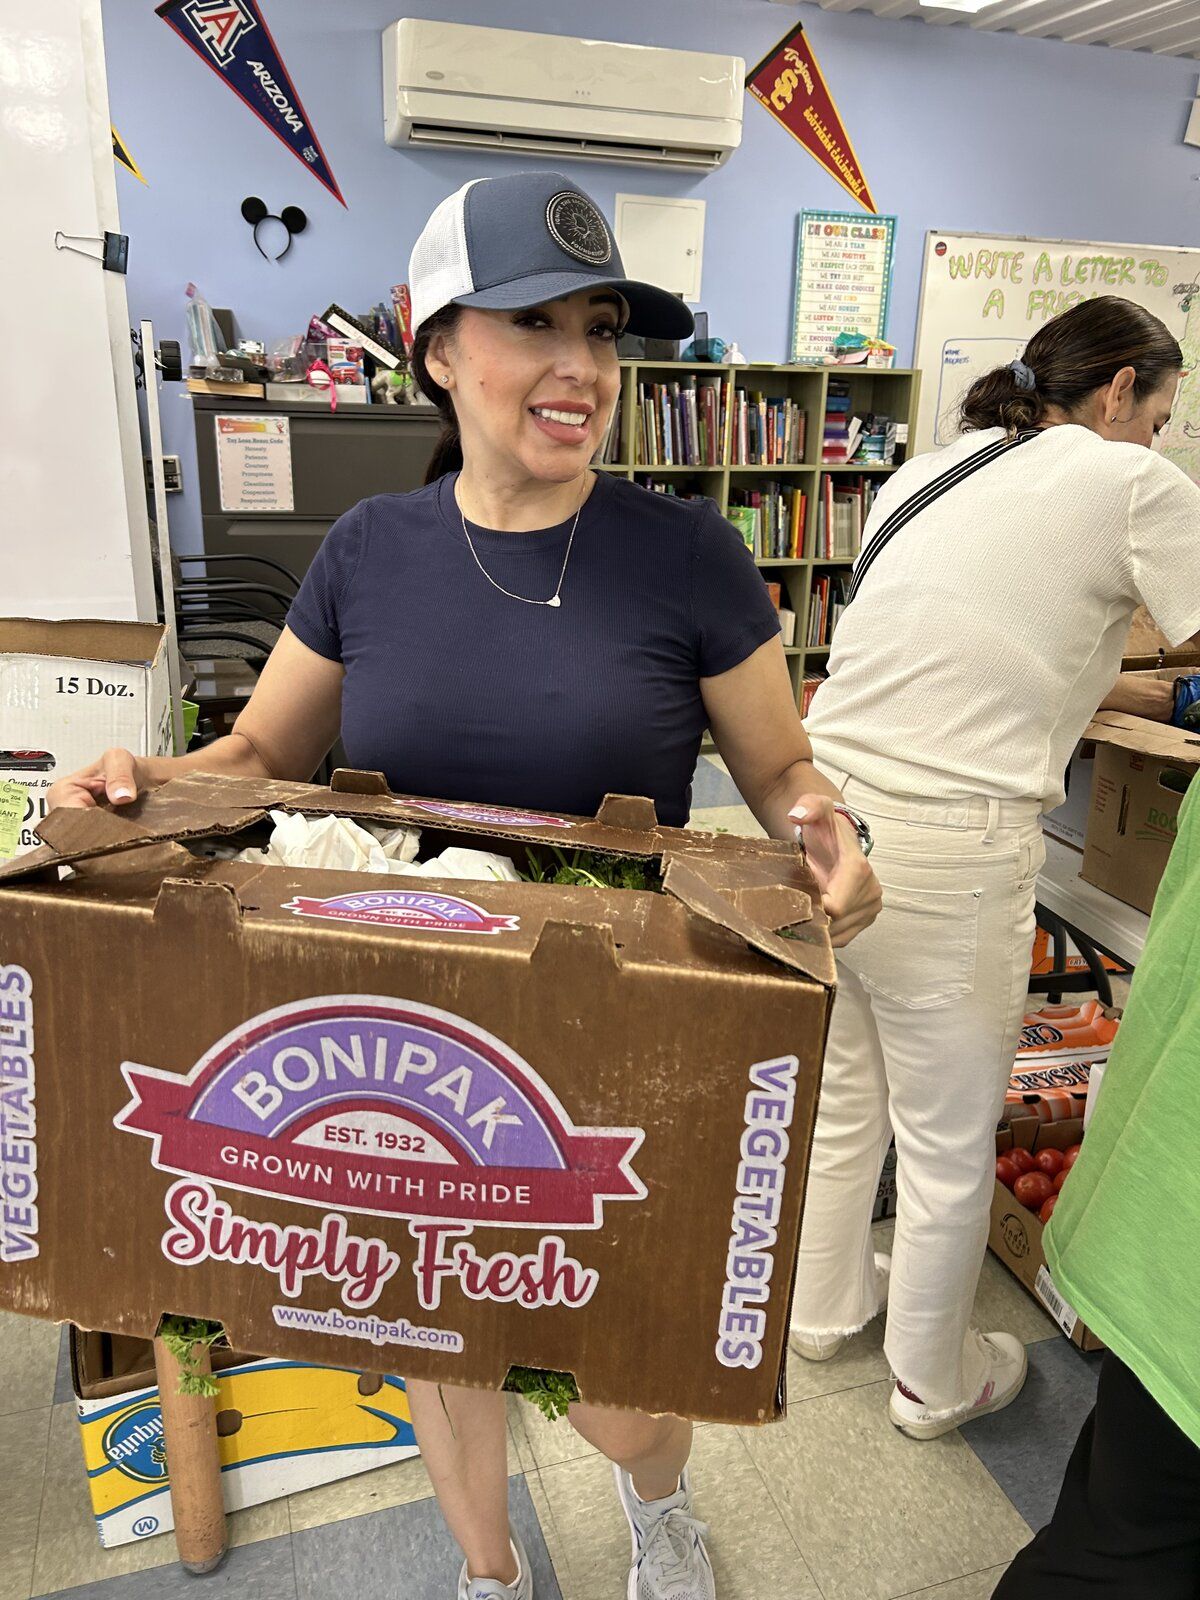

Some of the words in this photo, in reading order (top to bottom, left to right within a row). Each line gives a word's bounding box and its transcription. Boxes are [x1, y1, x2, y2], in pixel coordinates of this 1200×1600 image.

[784, 47, 814, 95] Trojans
[247, 60, 304, 134] ARIZONA
[803, 108, 835, 152] SOUTHERN
[830, 149, 863, 196] CALIFORNIA
[808, 224, 821, 236] IN
[824, 224, 848, 237] OUR
[851, 226, 885, 240] CLASS
[842, 252, 866, 260] POSITIVE
[949, 249, 1024, 284] WRITE
[1034, 251, 1053, 284] A
[1060, 255, 1136, 286] LETTER
[1139, 259, 1169, 287] TO
[983, 288, 1004, 320] A
[55, 676, 79, 694] 15
[86, 677, 135, 698] Doz.
[0, 810, 17, 818] ANT
[328, 910, 380, 921] GROWN
[385, 917, 420, 926] WITH
[425, 920, 466, 929] PRIDE
[343, 896, 467, 917] BONIPAK
[231, 1034, 524, 1150] BONIPAK
[0, 972, 33, 1255] VEGETABLES
[324, 1124, 367, 1145] EST.
[374, 1131, 426, 1154] 1932
[220, 1145, 333, 1185] GROWN
[347, 1169, 424, 1197] WITH
[439, 1180, 531, 1204] PRIDE
[722, 1062, 792, 1362] VEGETABLES
[166, 1184, 393, 1302] Simply
[413, 1224, 592, 1305] Fresh
[277, 1307, 459, 1346] www.bonipak.com
